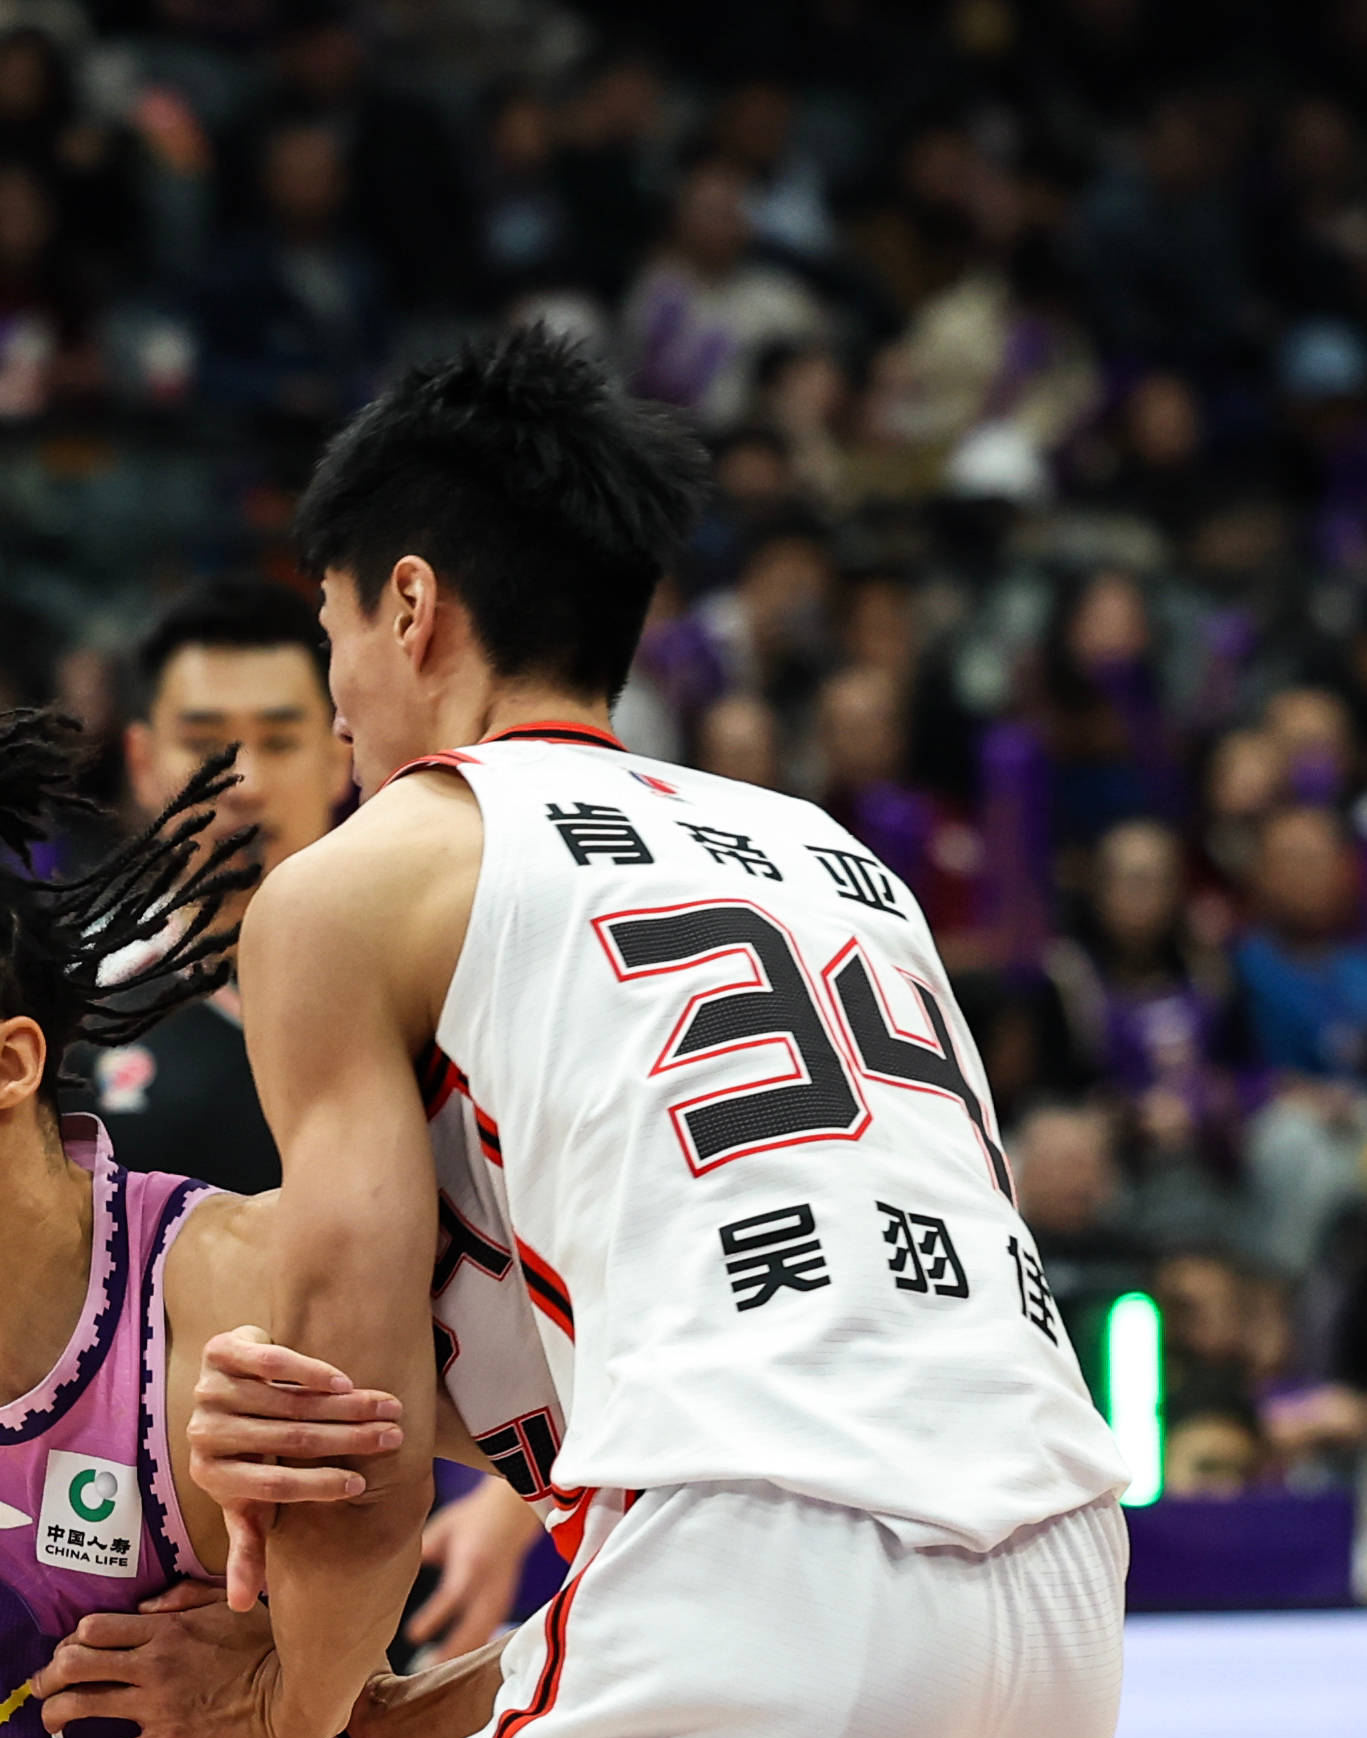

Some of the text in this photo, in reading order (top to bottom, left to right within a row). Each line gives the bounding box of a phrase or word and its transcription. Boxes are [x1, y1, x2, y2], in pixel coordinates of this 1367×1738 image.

[544, 801, 908, 921] 肯帝亚
[590, 897, 1018, 1210] 34
[44, 1544, 129, 1567] CHINA LIFE
[46, 1524, 132, 1555] 中国人寿
